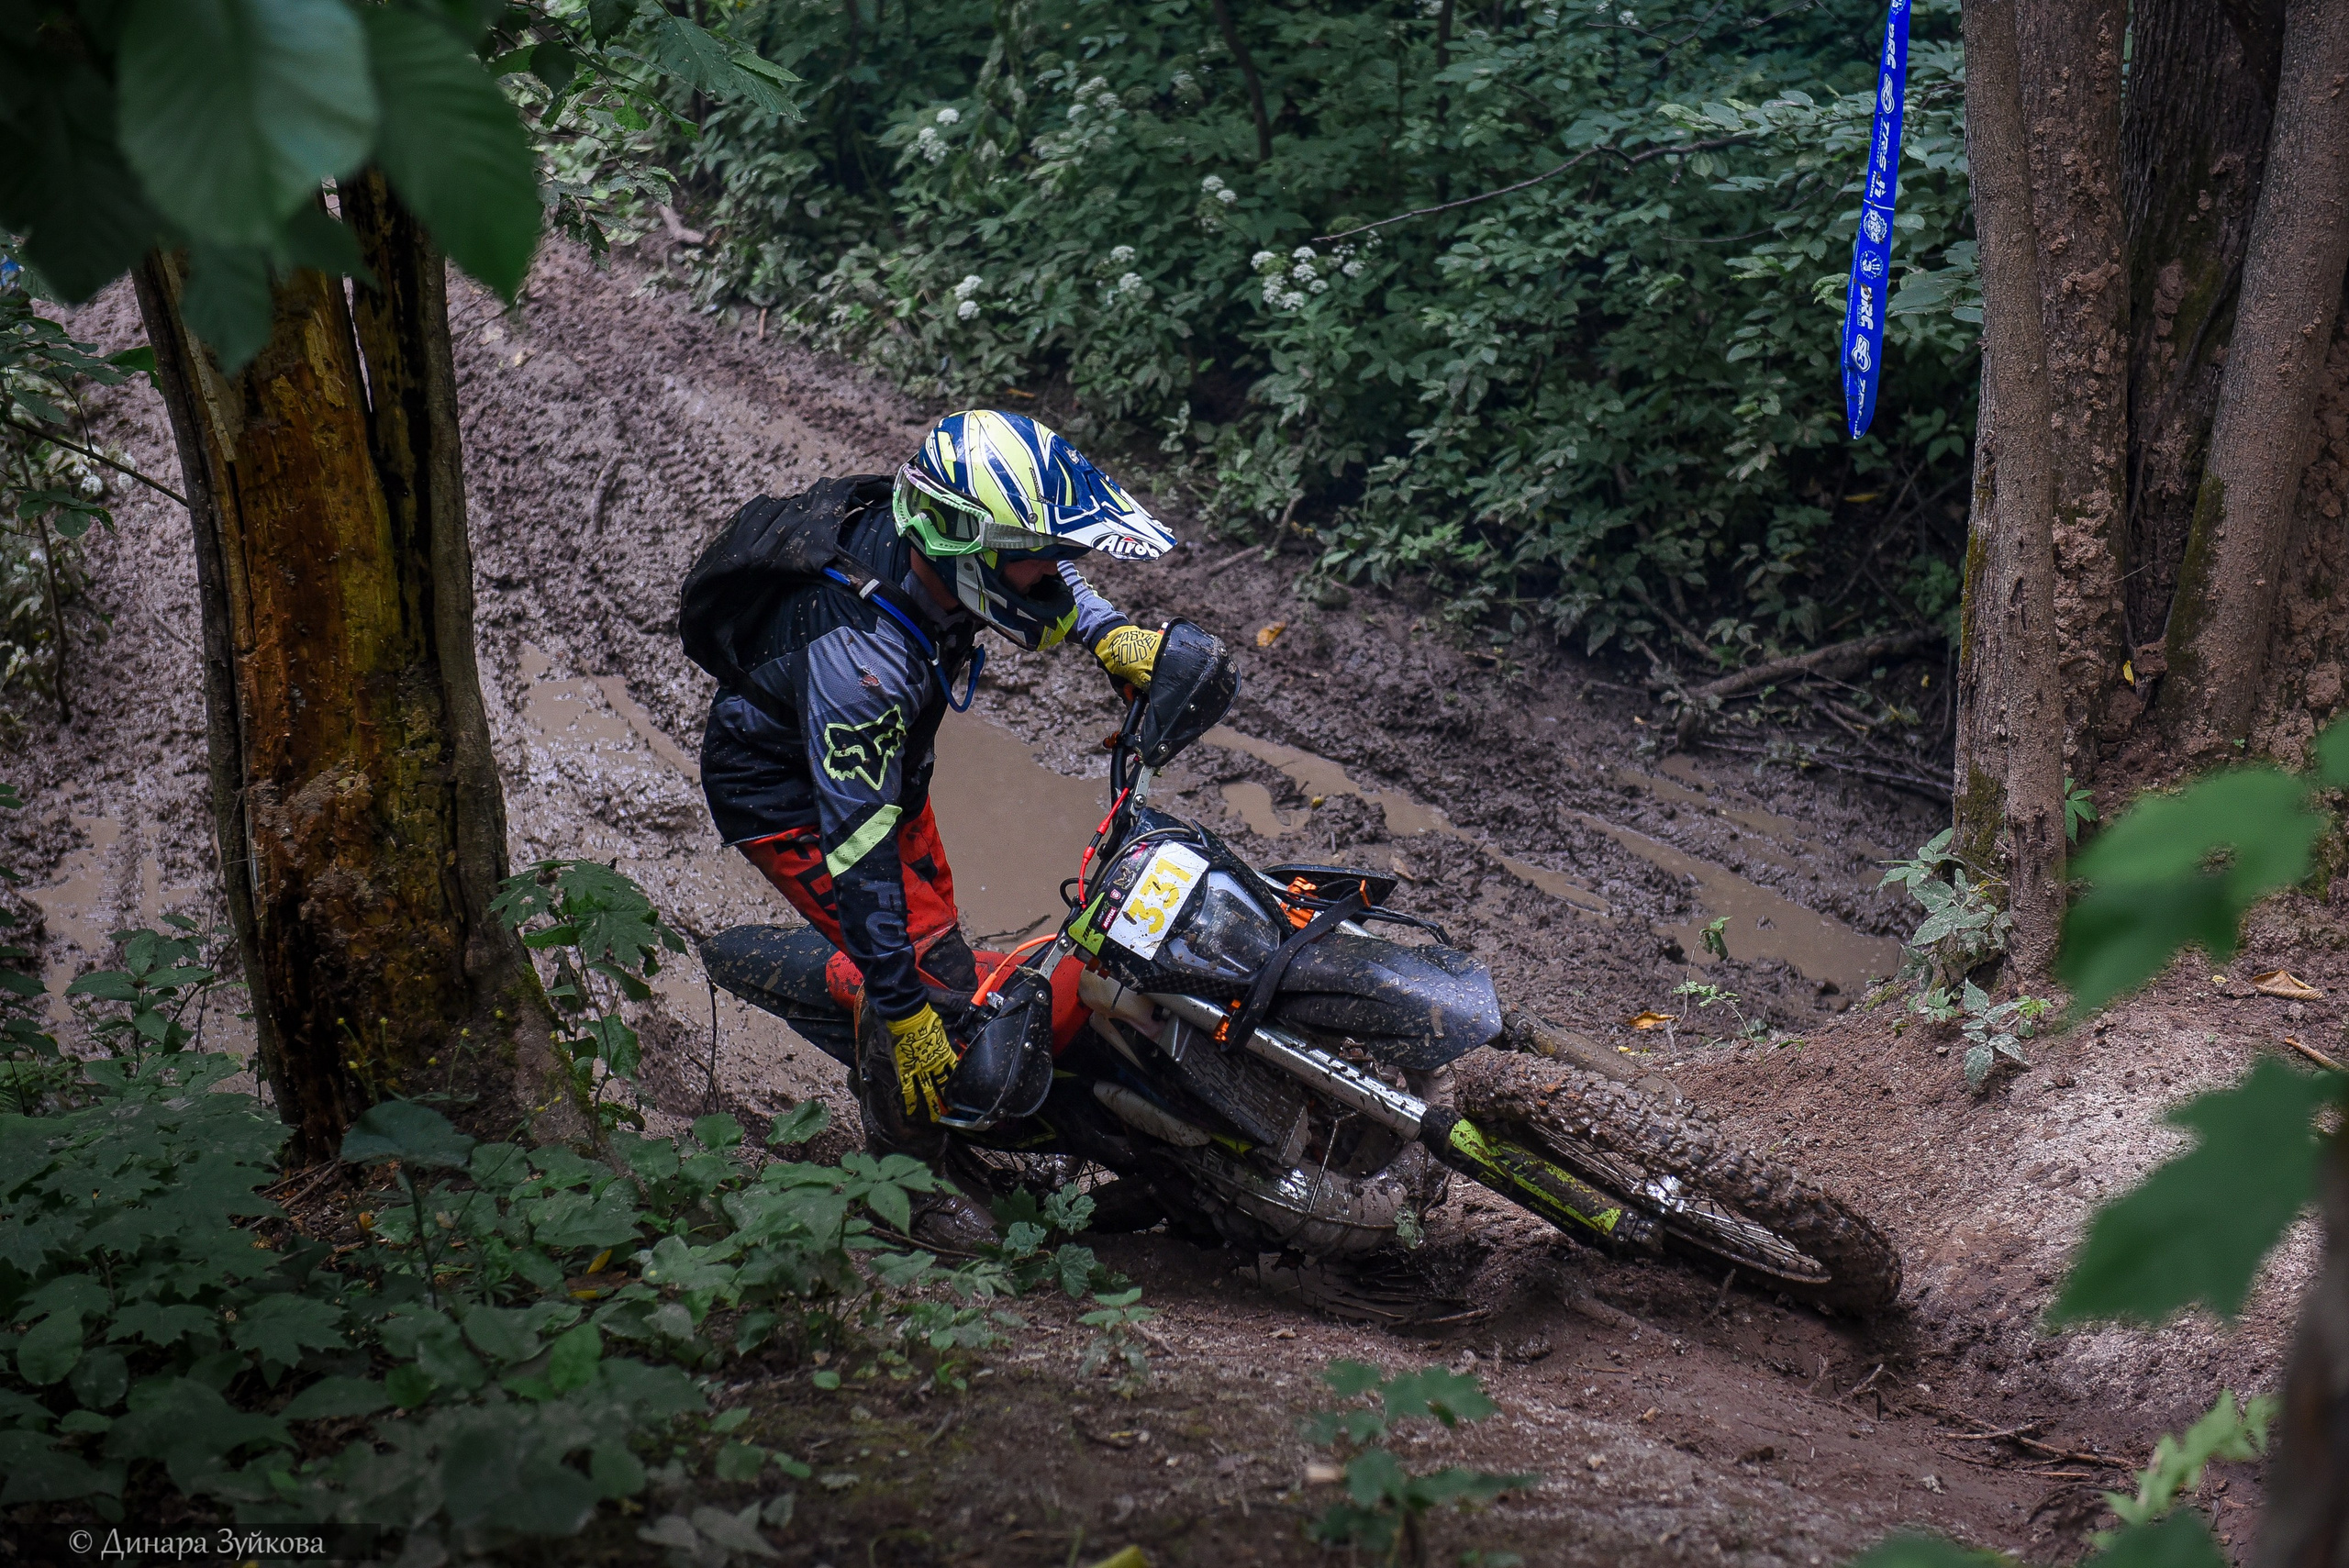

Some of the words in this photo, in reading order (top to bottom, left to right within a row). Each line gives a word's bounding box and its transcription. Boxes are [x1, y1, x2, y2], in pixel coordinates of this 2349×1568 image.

[1868, 208, 1881, 244] DRC
[1859, 286, 1874, 330] DRC
[1851, 334, 1872, 373] S3
[1108, 630, 1144, 652] FAST
[1111, 635, 1158, 667] HOUSE
[859, 877, 908, 954] FO
[1128, 858, 1194, 934] 331
